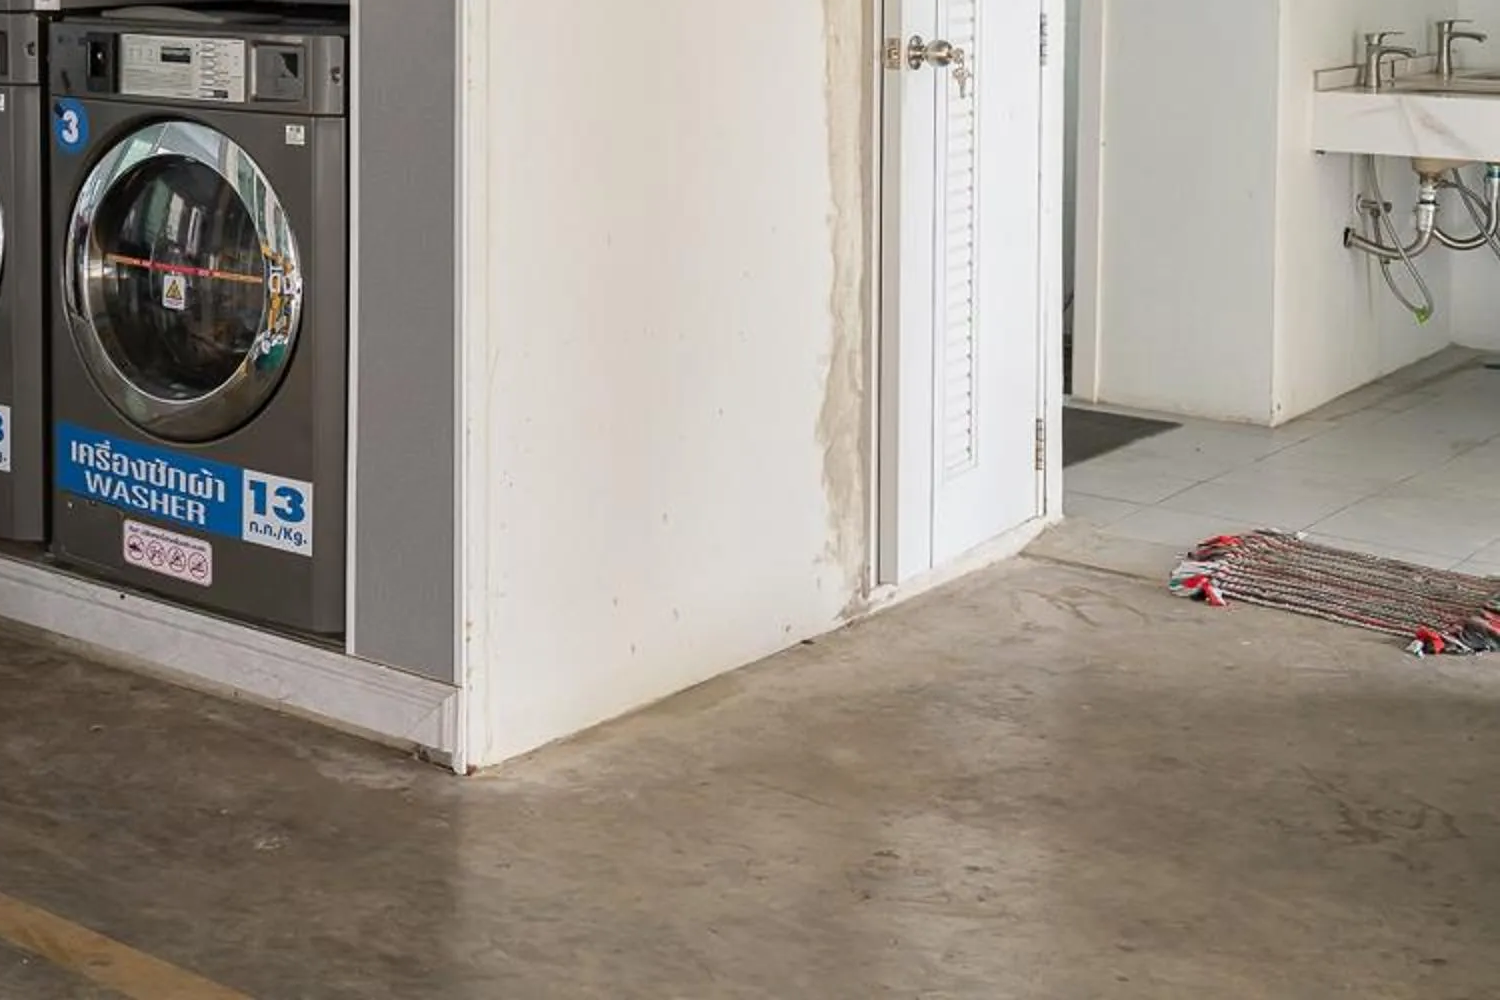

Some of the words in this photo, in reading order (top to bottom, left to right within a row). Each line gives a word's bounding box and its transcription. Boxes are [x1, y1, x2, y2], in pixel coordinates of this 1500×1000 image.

[61, 110, 79, 144] 3
[70, 439, 226, 503] เครื่องซักผ้า
[84, 470, 207, 525] WASHER
[248, 479, 306, 523] 13
